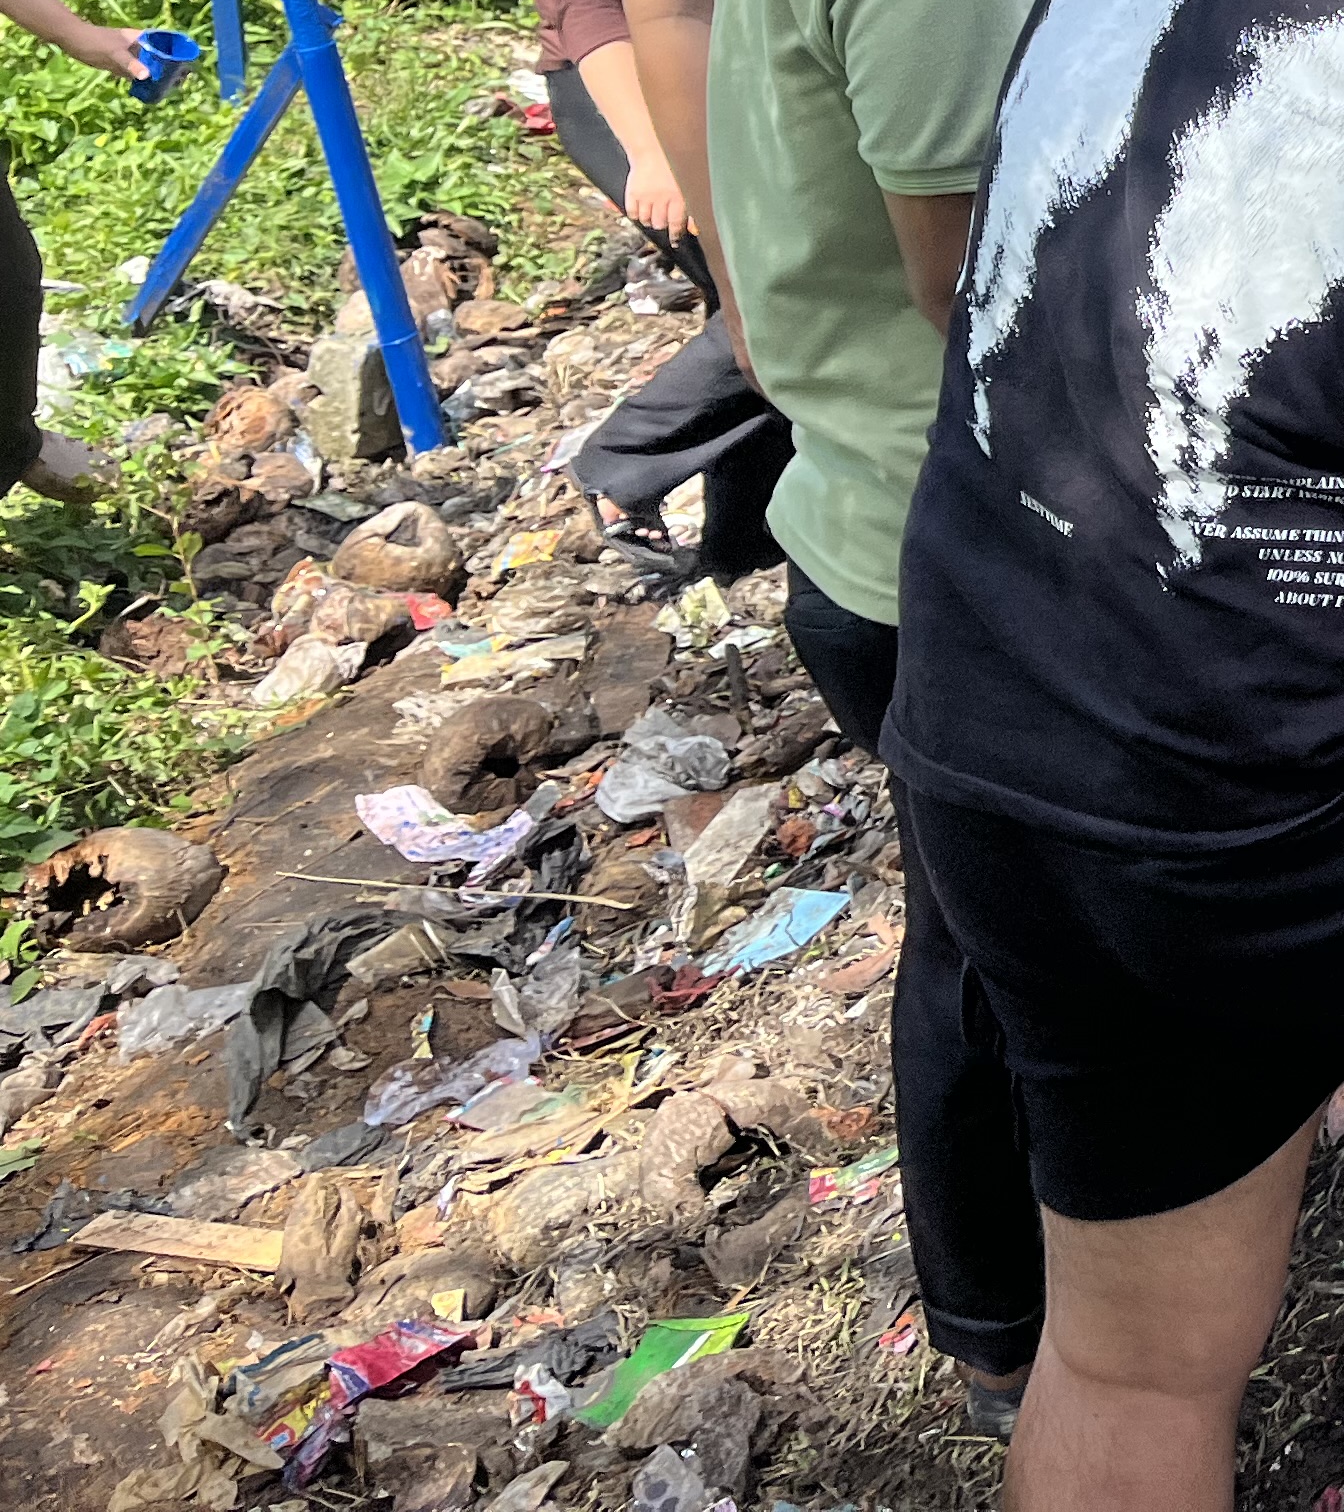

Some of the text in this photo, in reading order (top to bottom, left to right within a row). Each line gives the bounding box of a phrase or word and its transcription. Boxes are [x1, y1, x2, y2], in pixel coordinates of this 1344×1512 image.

[1241, 484, 1296, 499] START
[1230, 526, 1300, 541] ASSUME
[1258, 548, 1323, 564] UNLESS
[1266, 568, 1310, 584] 100%
[1274, 590, 1334, 608] ABOUT
